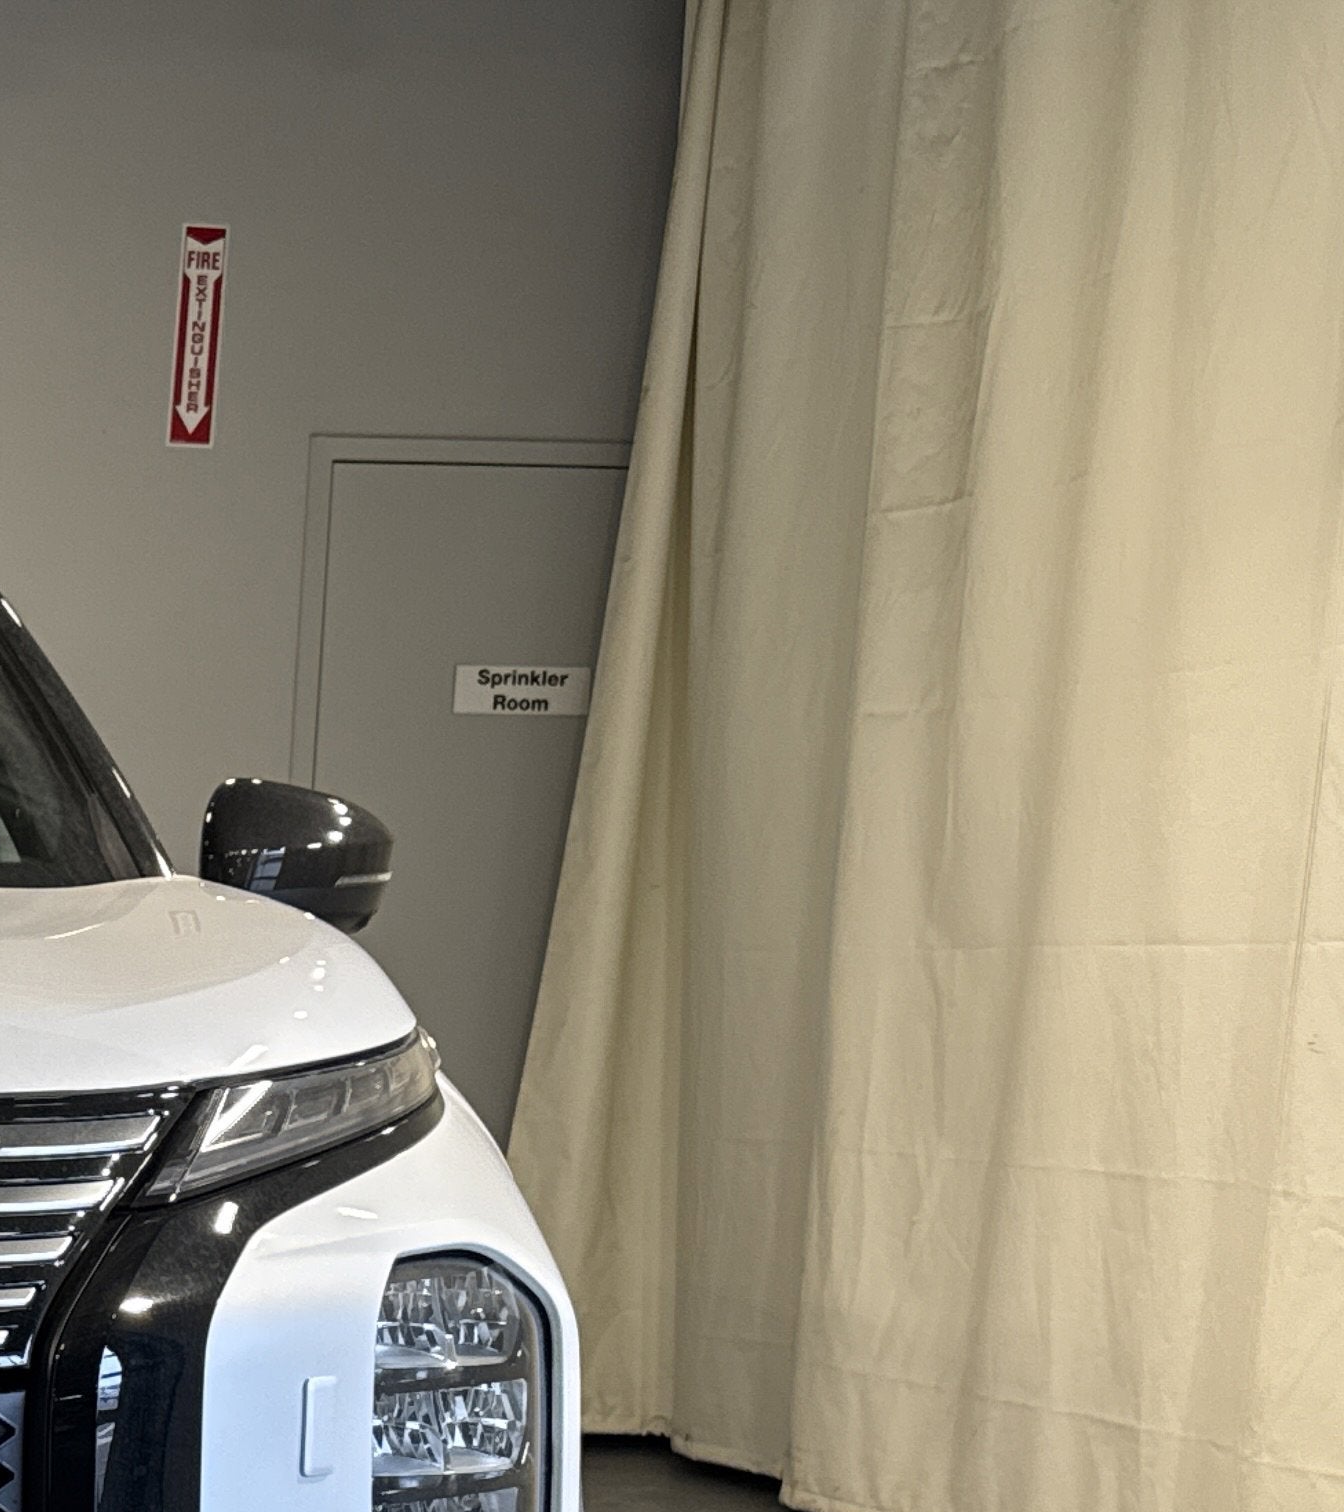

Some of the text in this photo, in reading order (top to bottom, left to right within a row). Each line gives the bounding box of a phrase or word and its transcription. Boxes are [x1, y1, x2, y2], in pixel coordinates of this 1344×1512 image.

[186, 250, 221, 270] FIRE
[185, 274, 208, 414] EXTINGUISHER
[477, 668, 569, 688] Sprinkler
[492, 694, 549, 711] Room
